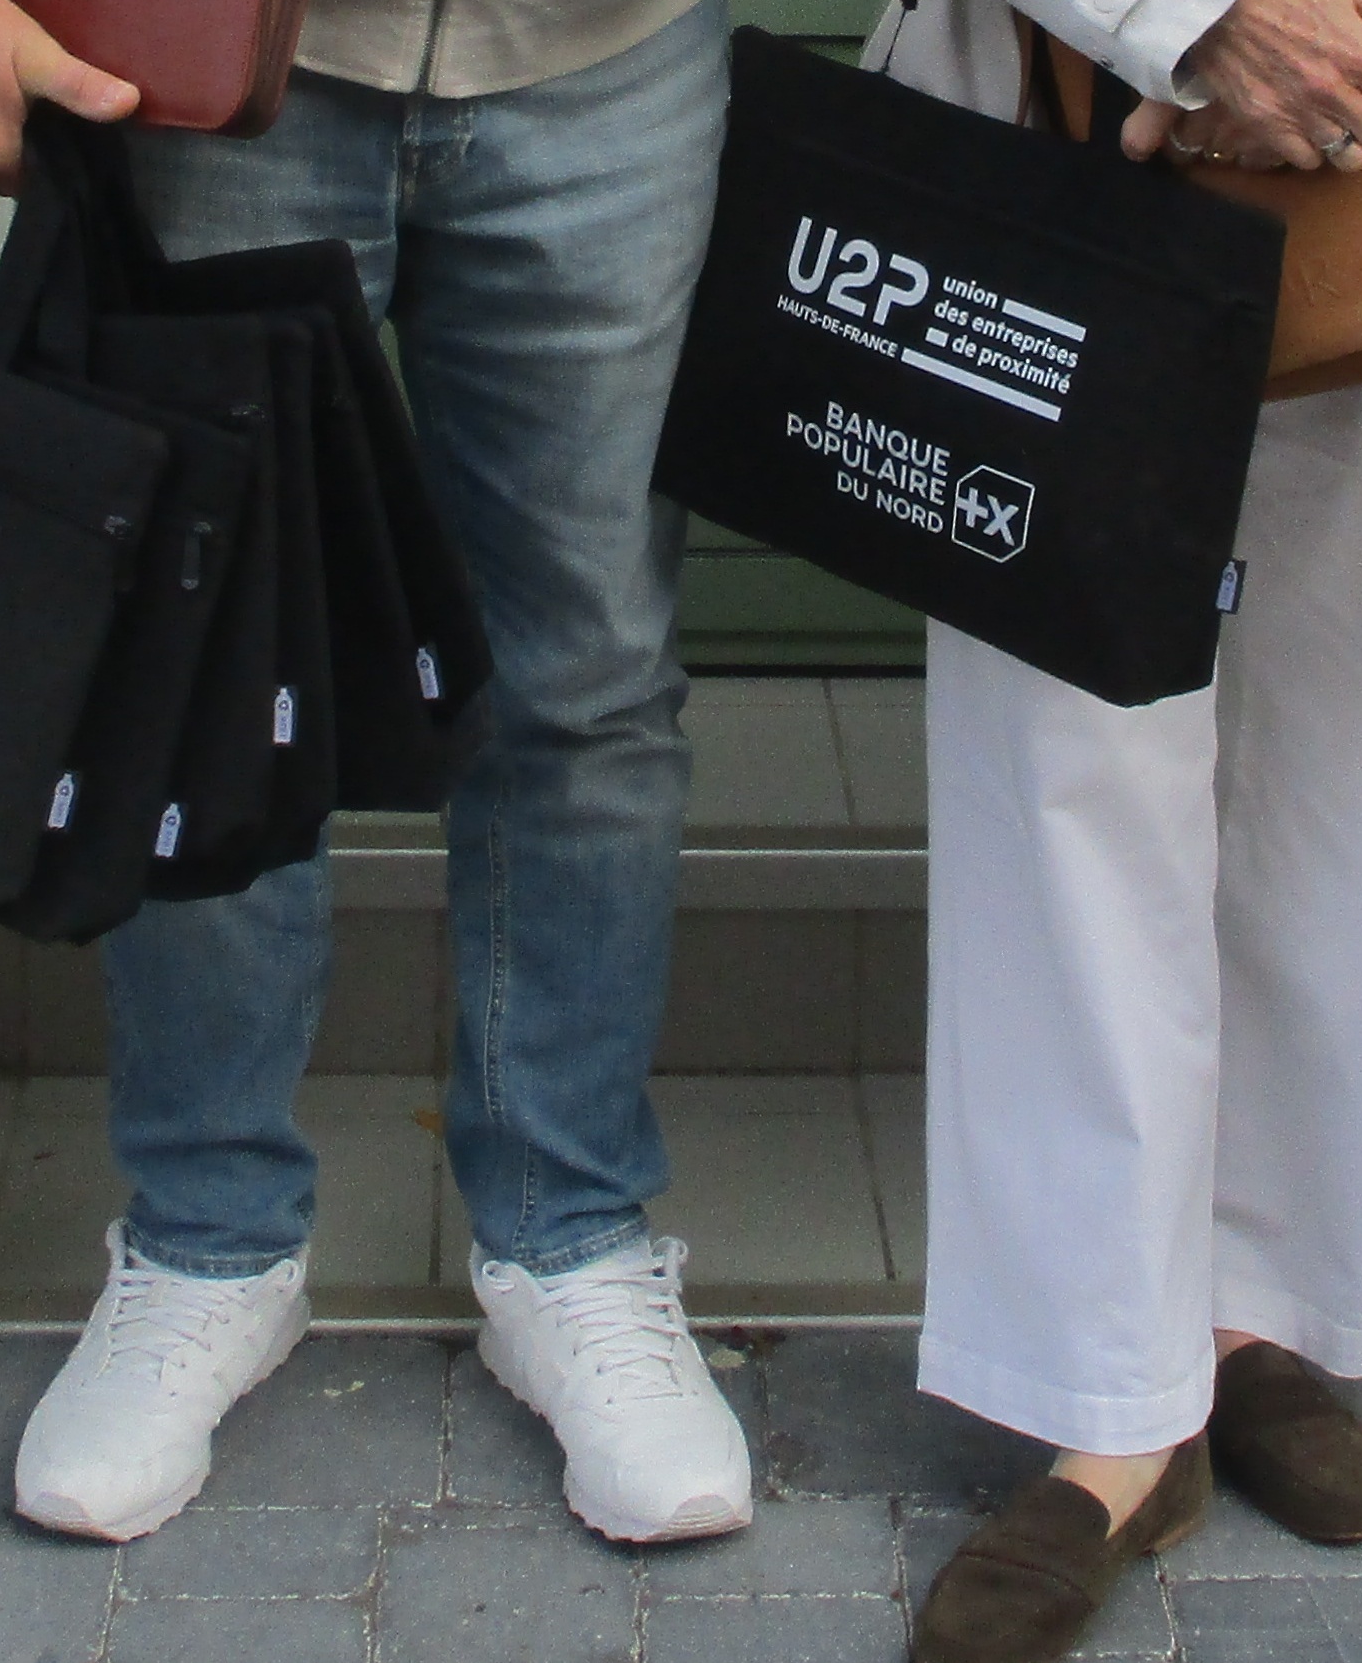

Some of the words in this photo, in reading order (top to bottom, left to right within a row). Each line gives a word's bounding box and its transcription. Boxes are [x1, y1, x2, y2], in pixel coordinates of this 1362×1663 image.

[787, 215, 929, 327] U2P
[942, 275, 998, 310] union
[776, 294, 900, 360] HAUTS-DE-FRANCE
[934, 300, 968, 328] des
[972, 314, 1079, 369] entreprises
[952, 334, 977, 358] de
[978, 348, 1072, 395] proximité
[786, 412, 947, 507] POPULAIRE
[826, 401, 951, 477] BANQUE
[836, 470, 870, 502] DU
[876, 488, 944, 536] NORD
